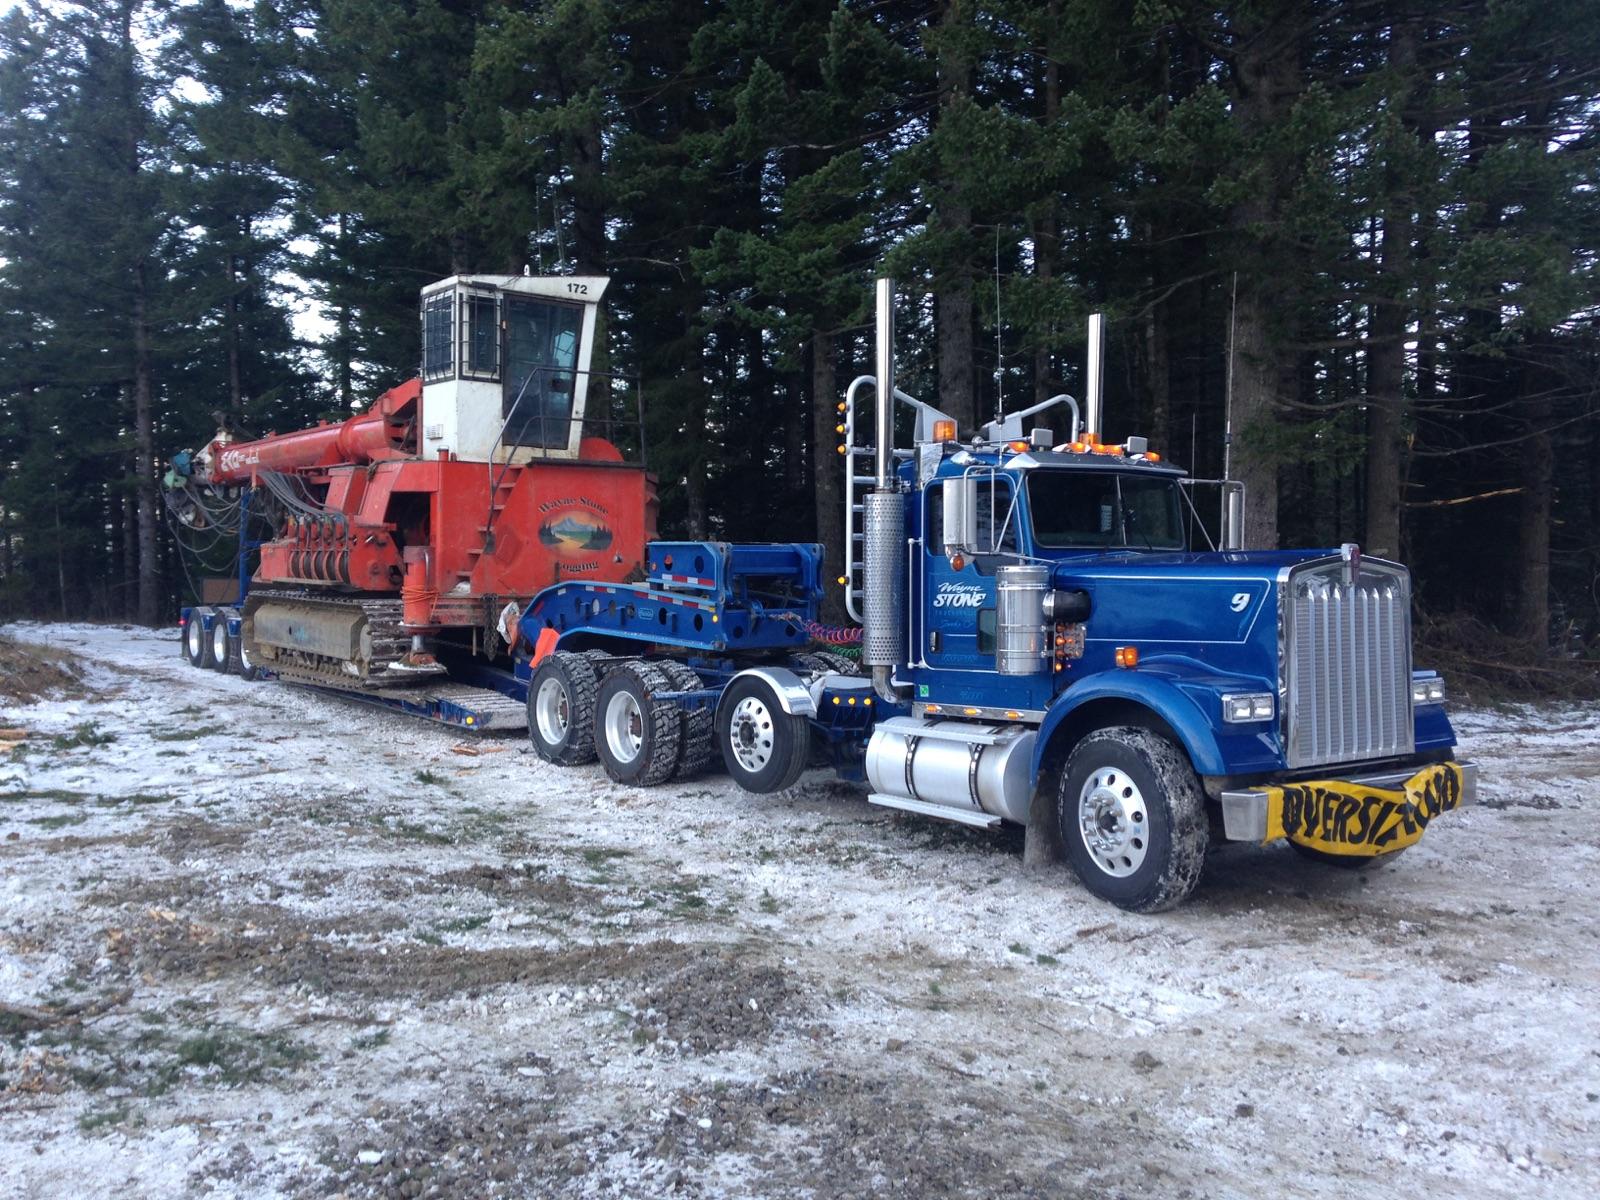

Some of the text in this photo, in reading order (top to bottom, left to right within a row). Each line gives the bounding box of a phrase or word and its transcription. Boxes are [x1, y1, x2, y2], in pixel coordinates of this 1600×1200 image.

[567, 282, 588, 295] 172
[538, 496, 608, 515] Wayne Stone
[559, 561, 599, 572] ogging
[938, 581, 984, 593] Wayne
[933, 592, 986, 607] STONE
[1230, 593, 1250, 612] 9
[1413, 766, 1460, 829] OAD
